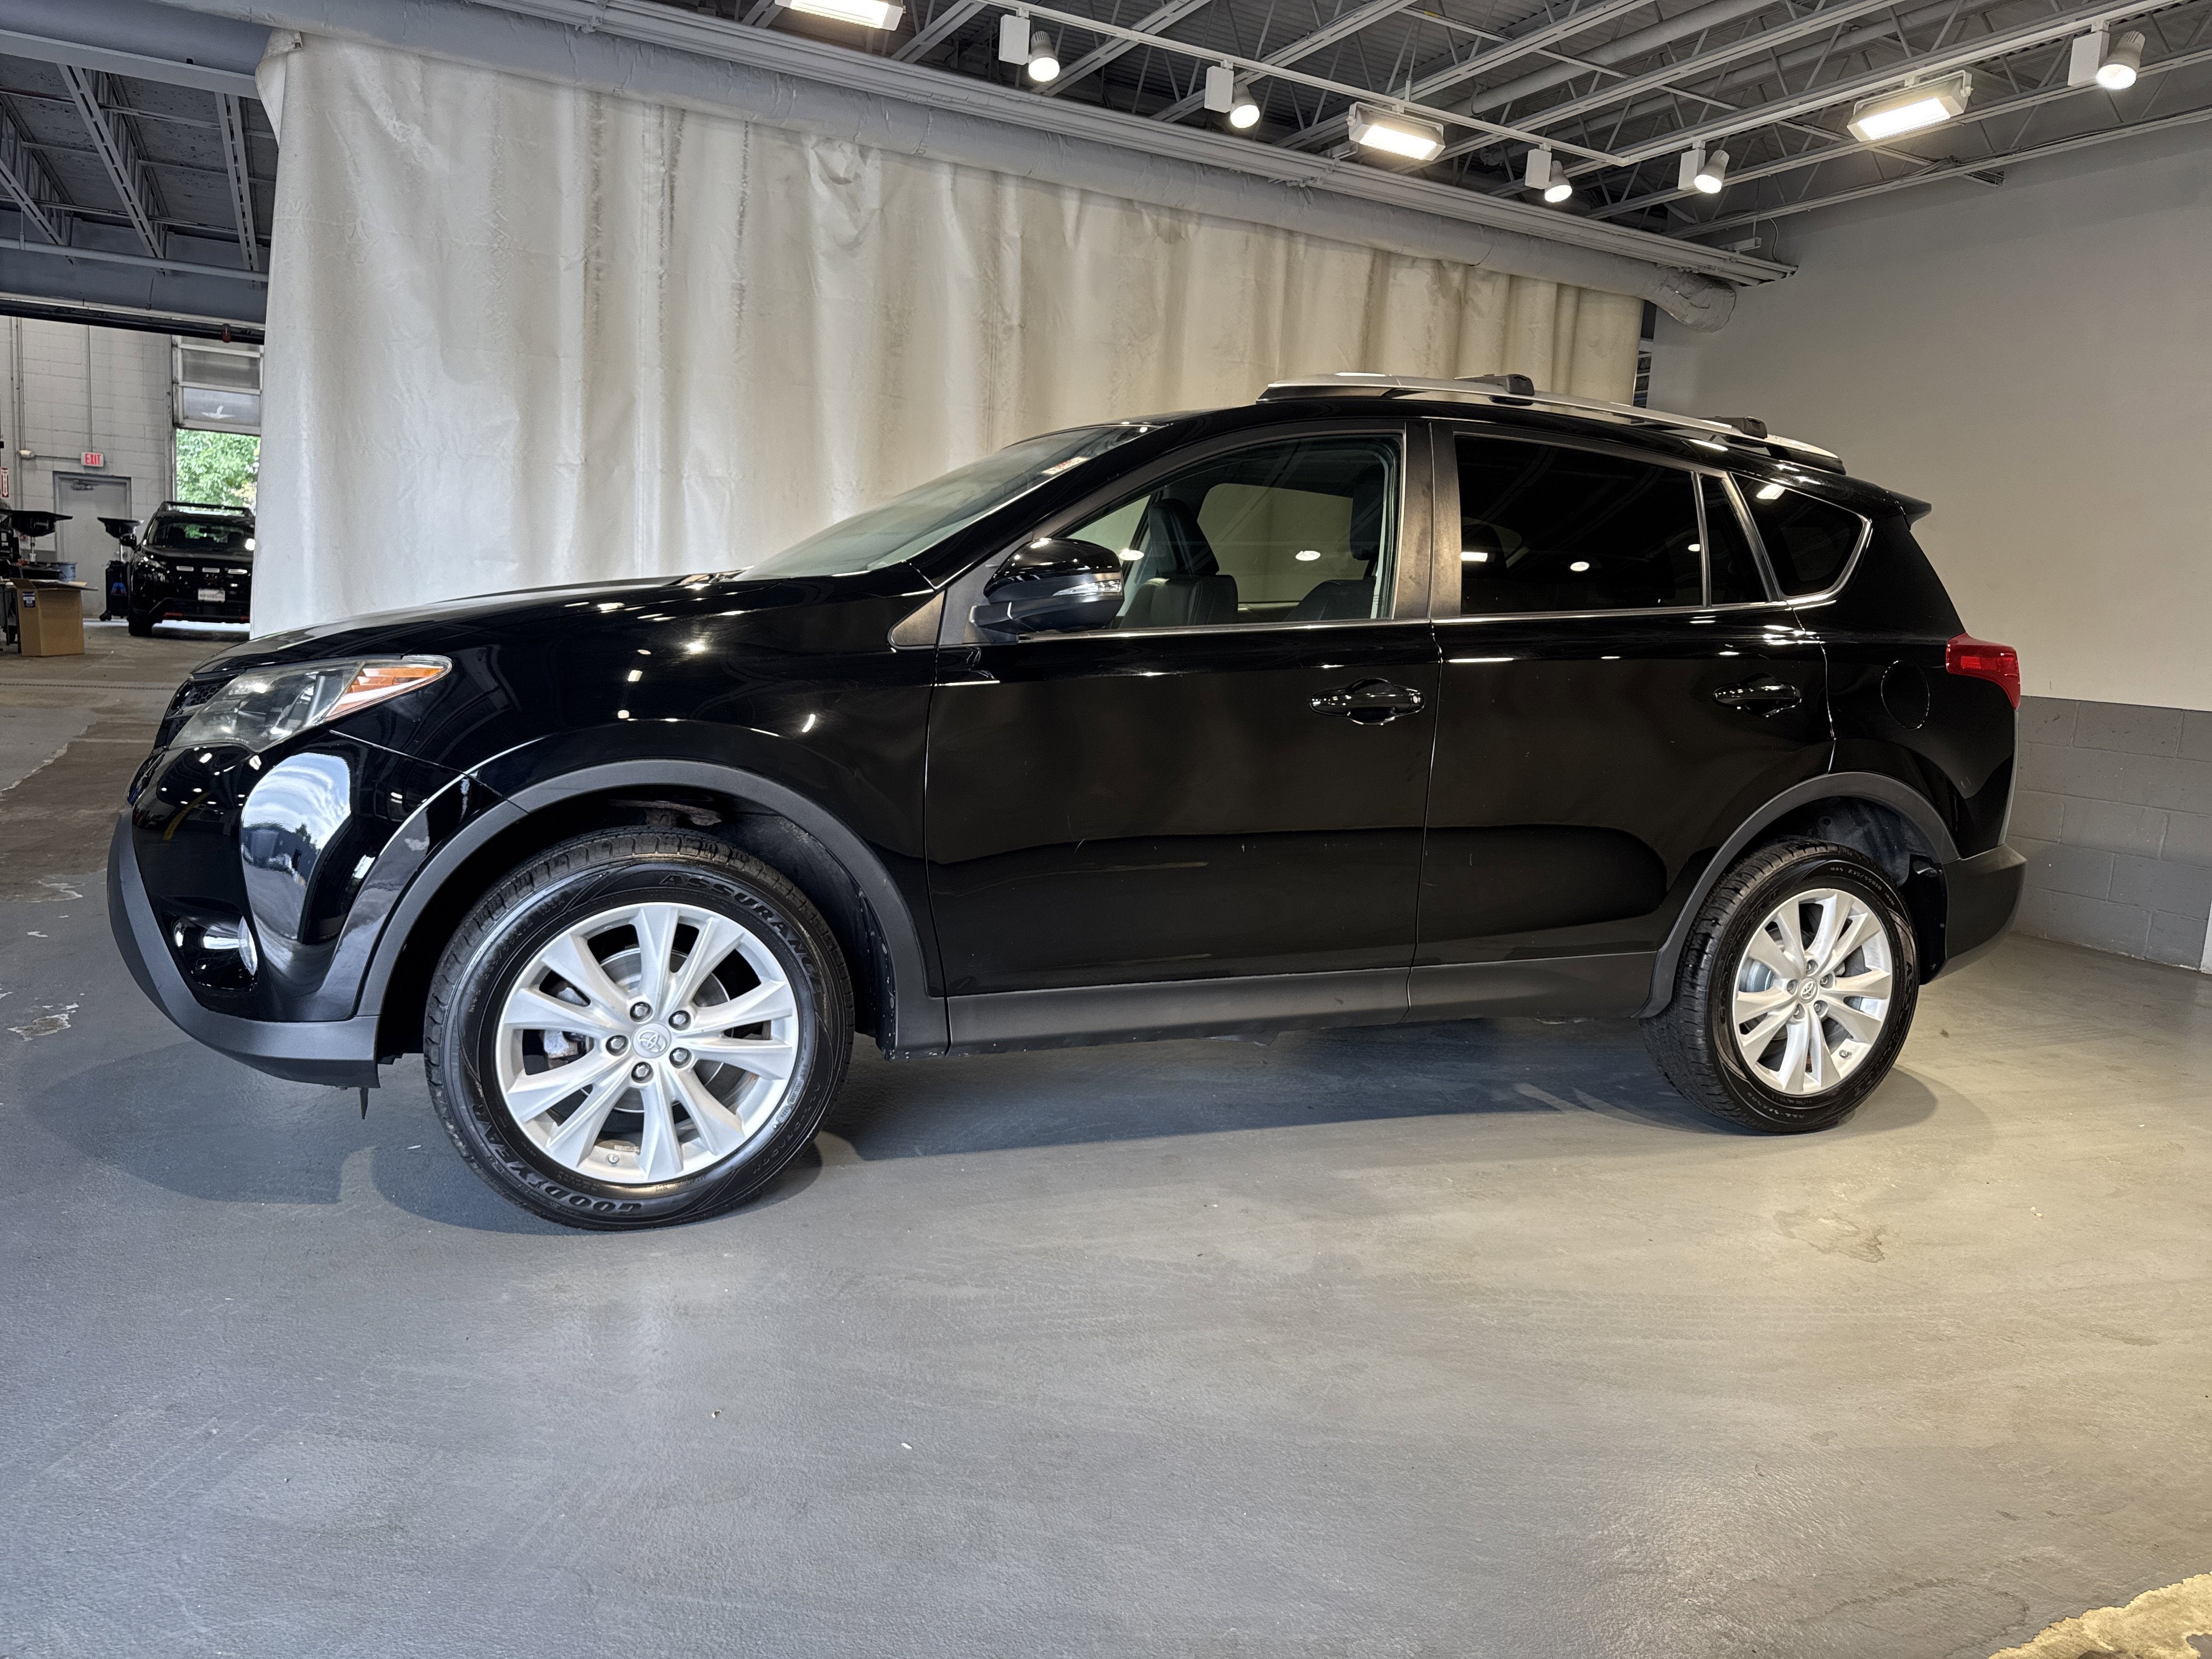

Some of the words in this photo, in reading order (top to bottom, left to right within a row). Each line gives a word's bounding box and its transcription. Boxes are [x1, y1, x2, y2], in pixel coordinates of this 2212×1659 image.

[85, 453, 101, 465] EXIT
[659, 873, 824, 996] ASSURANCE
[472, 1103, 643, 1214] GOODYEAR
